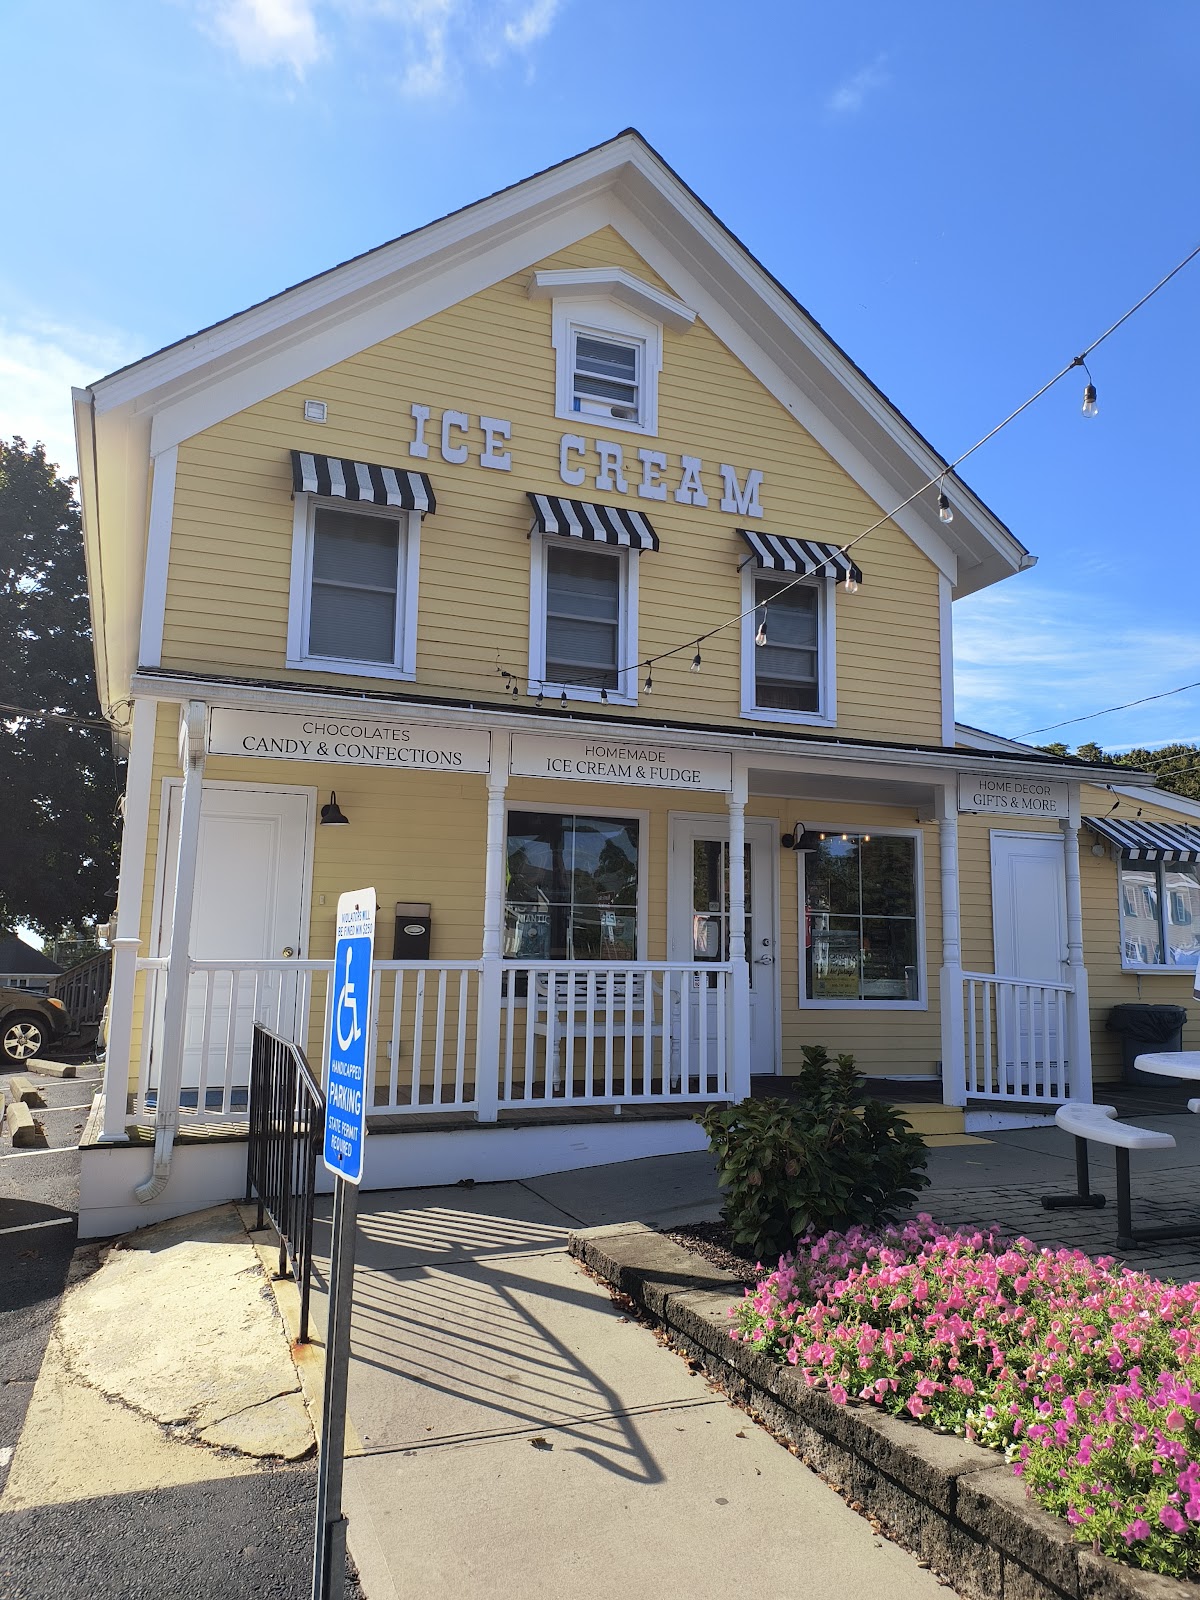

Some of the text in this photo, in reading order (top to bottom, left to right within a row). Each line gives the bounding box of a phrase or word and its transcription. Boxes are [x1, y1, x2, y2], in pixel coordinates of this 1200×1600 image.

[409, 403, 764, 518] ICE CREAM
[302, 721, 411, 742] CHOCOLATES
[242, 735, 462, 766] CANDY & CONFECTIONS
[585, 745, 666, 763] HOMEMADE
[546, 757, 701, 783] ICE CREAM & FUDGE
[979, 780, 1051, 796] HOME DECOR
[973, 793, 1057, 811] GIFTS & MORE
[338, 927, 343, 936] BE
[331, 1060, 361, 1080] HANDICAPPED
[330, 1082, 360, 1115] PARKING
[328, 1115, 359, 1141] STATE PERMIT
[330, 1134, 352, 1158] REQUIRED
